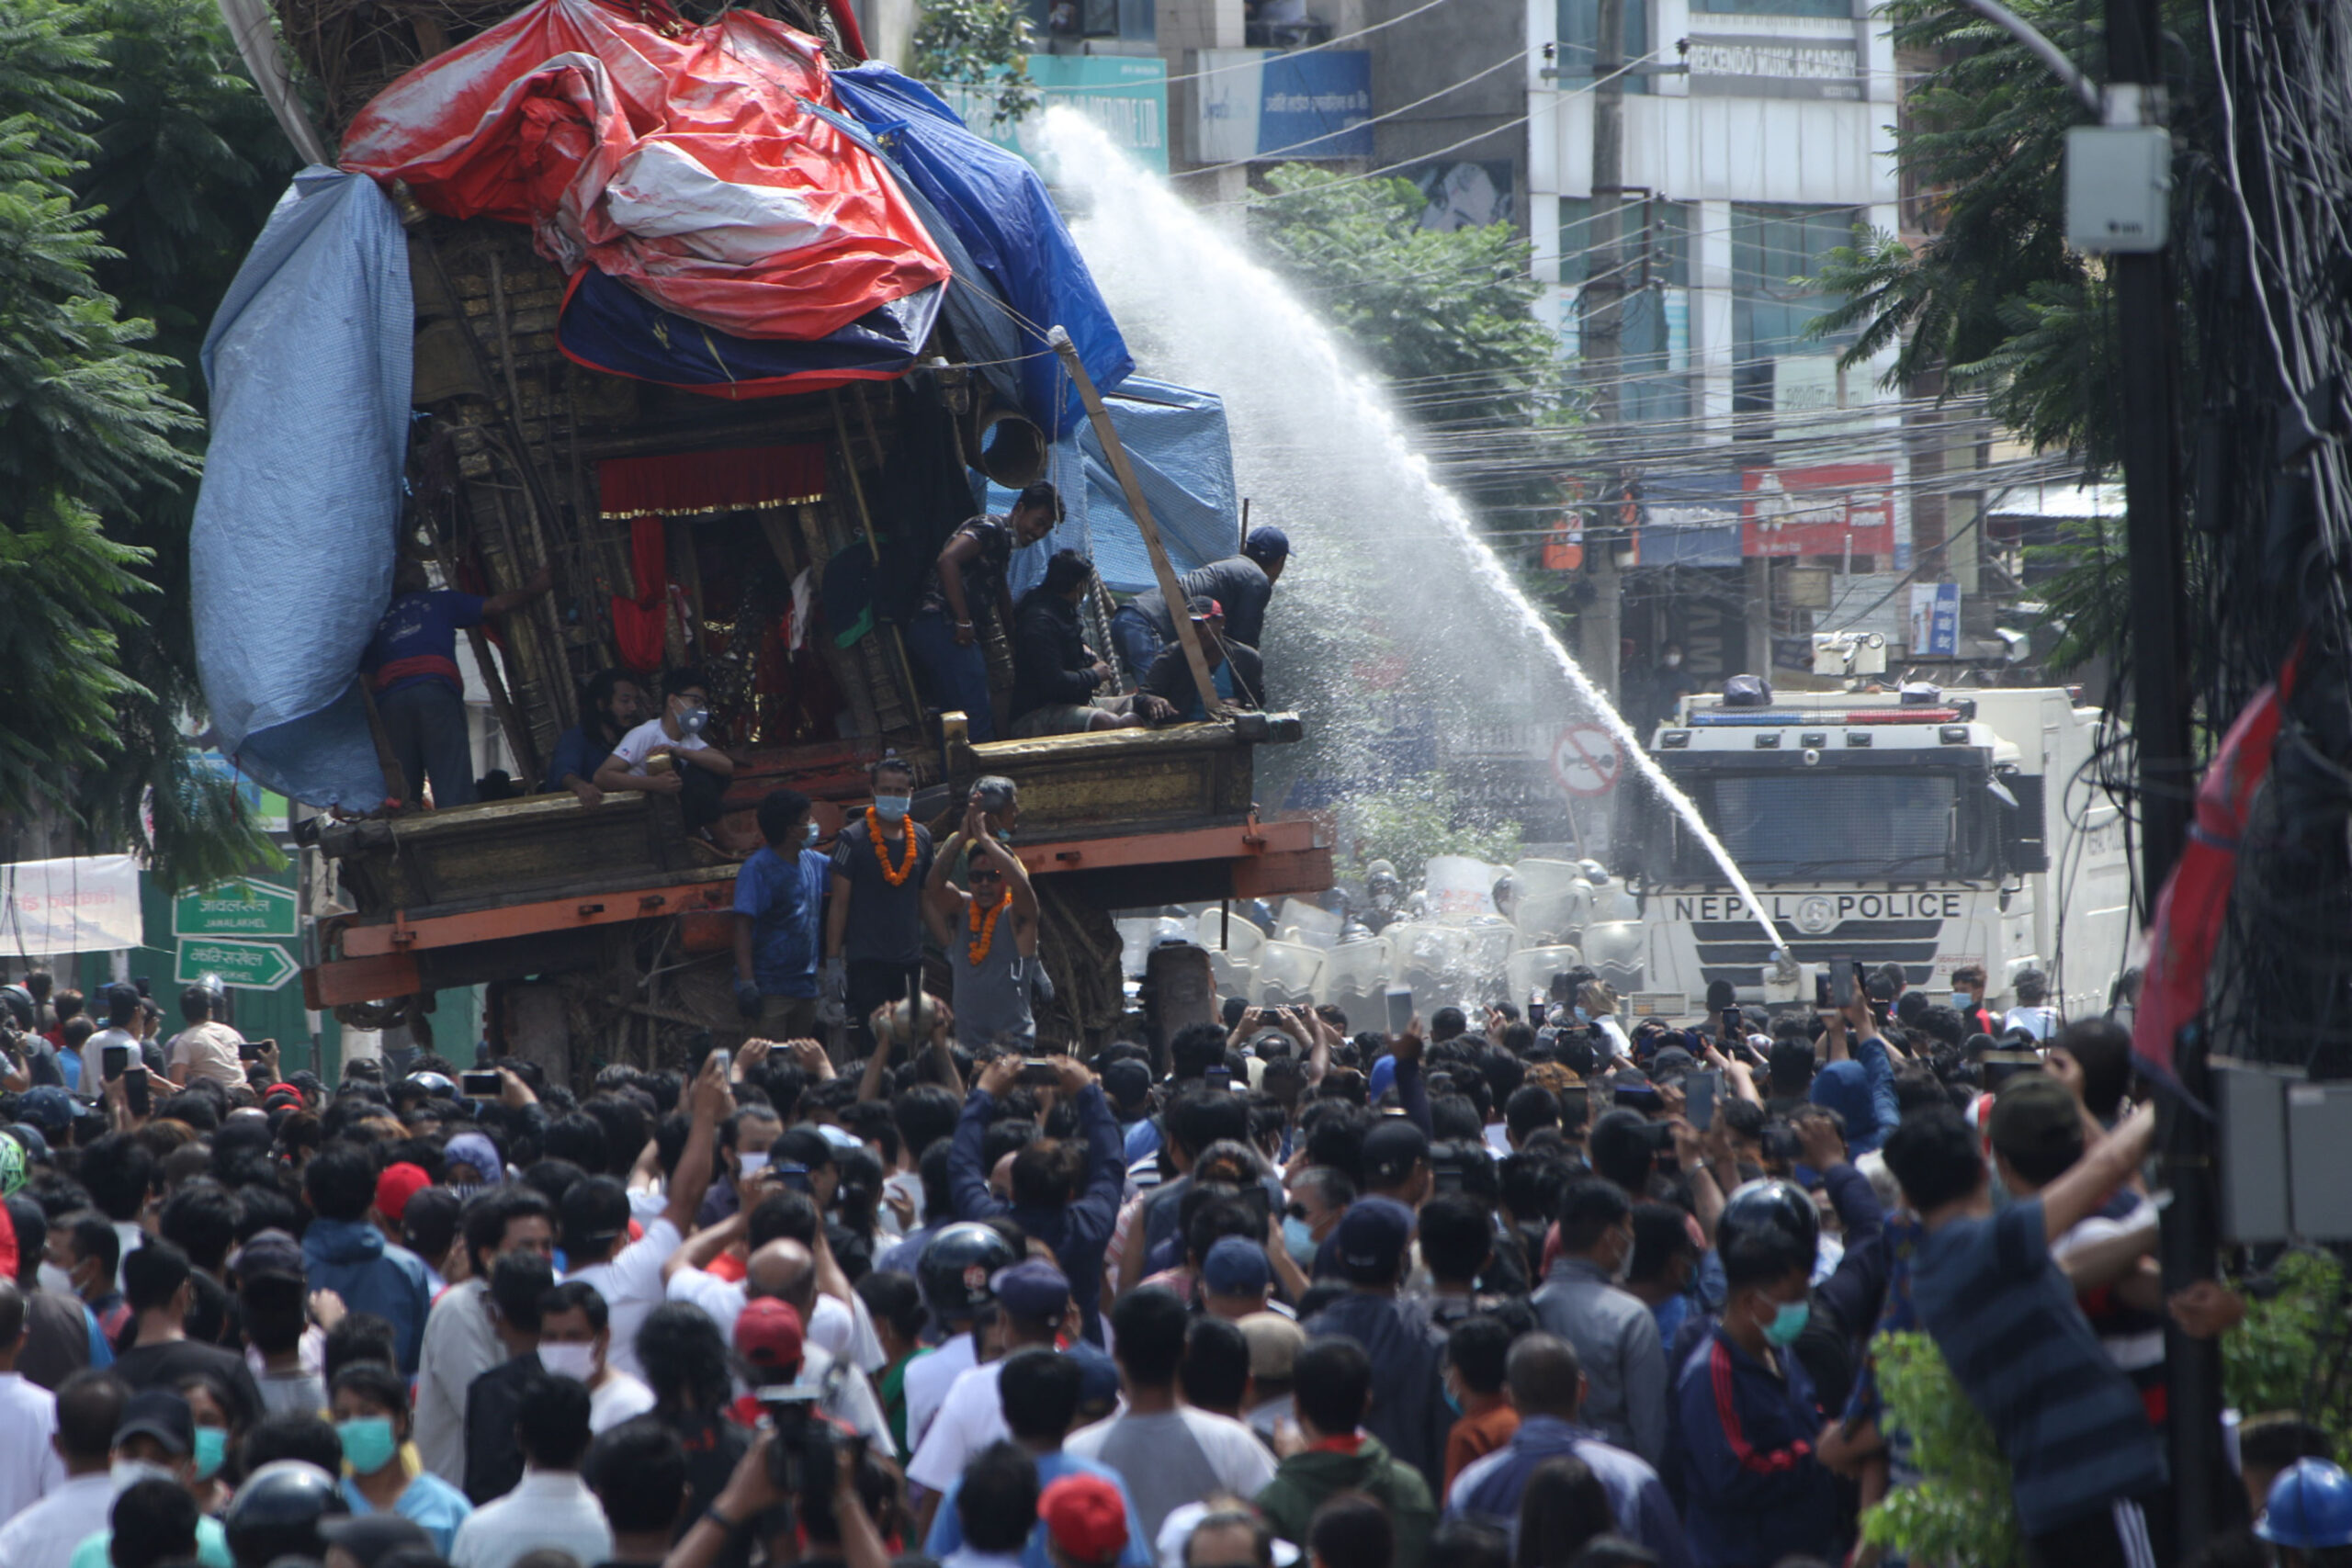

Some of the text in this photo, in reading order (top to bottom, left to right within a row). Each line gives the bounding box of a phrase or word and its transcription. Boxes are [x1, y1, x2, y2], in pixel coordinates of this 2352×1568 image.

[1690, 45, 1857, 79] RESCENDO MUSIC ACADEMY
[1838, 894, 1961, 919] POLICE
[204, 918, 267, 928] JAWALAKHEL
